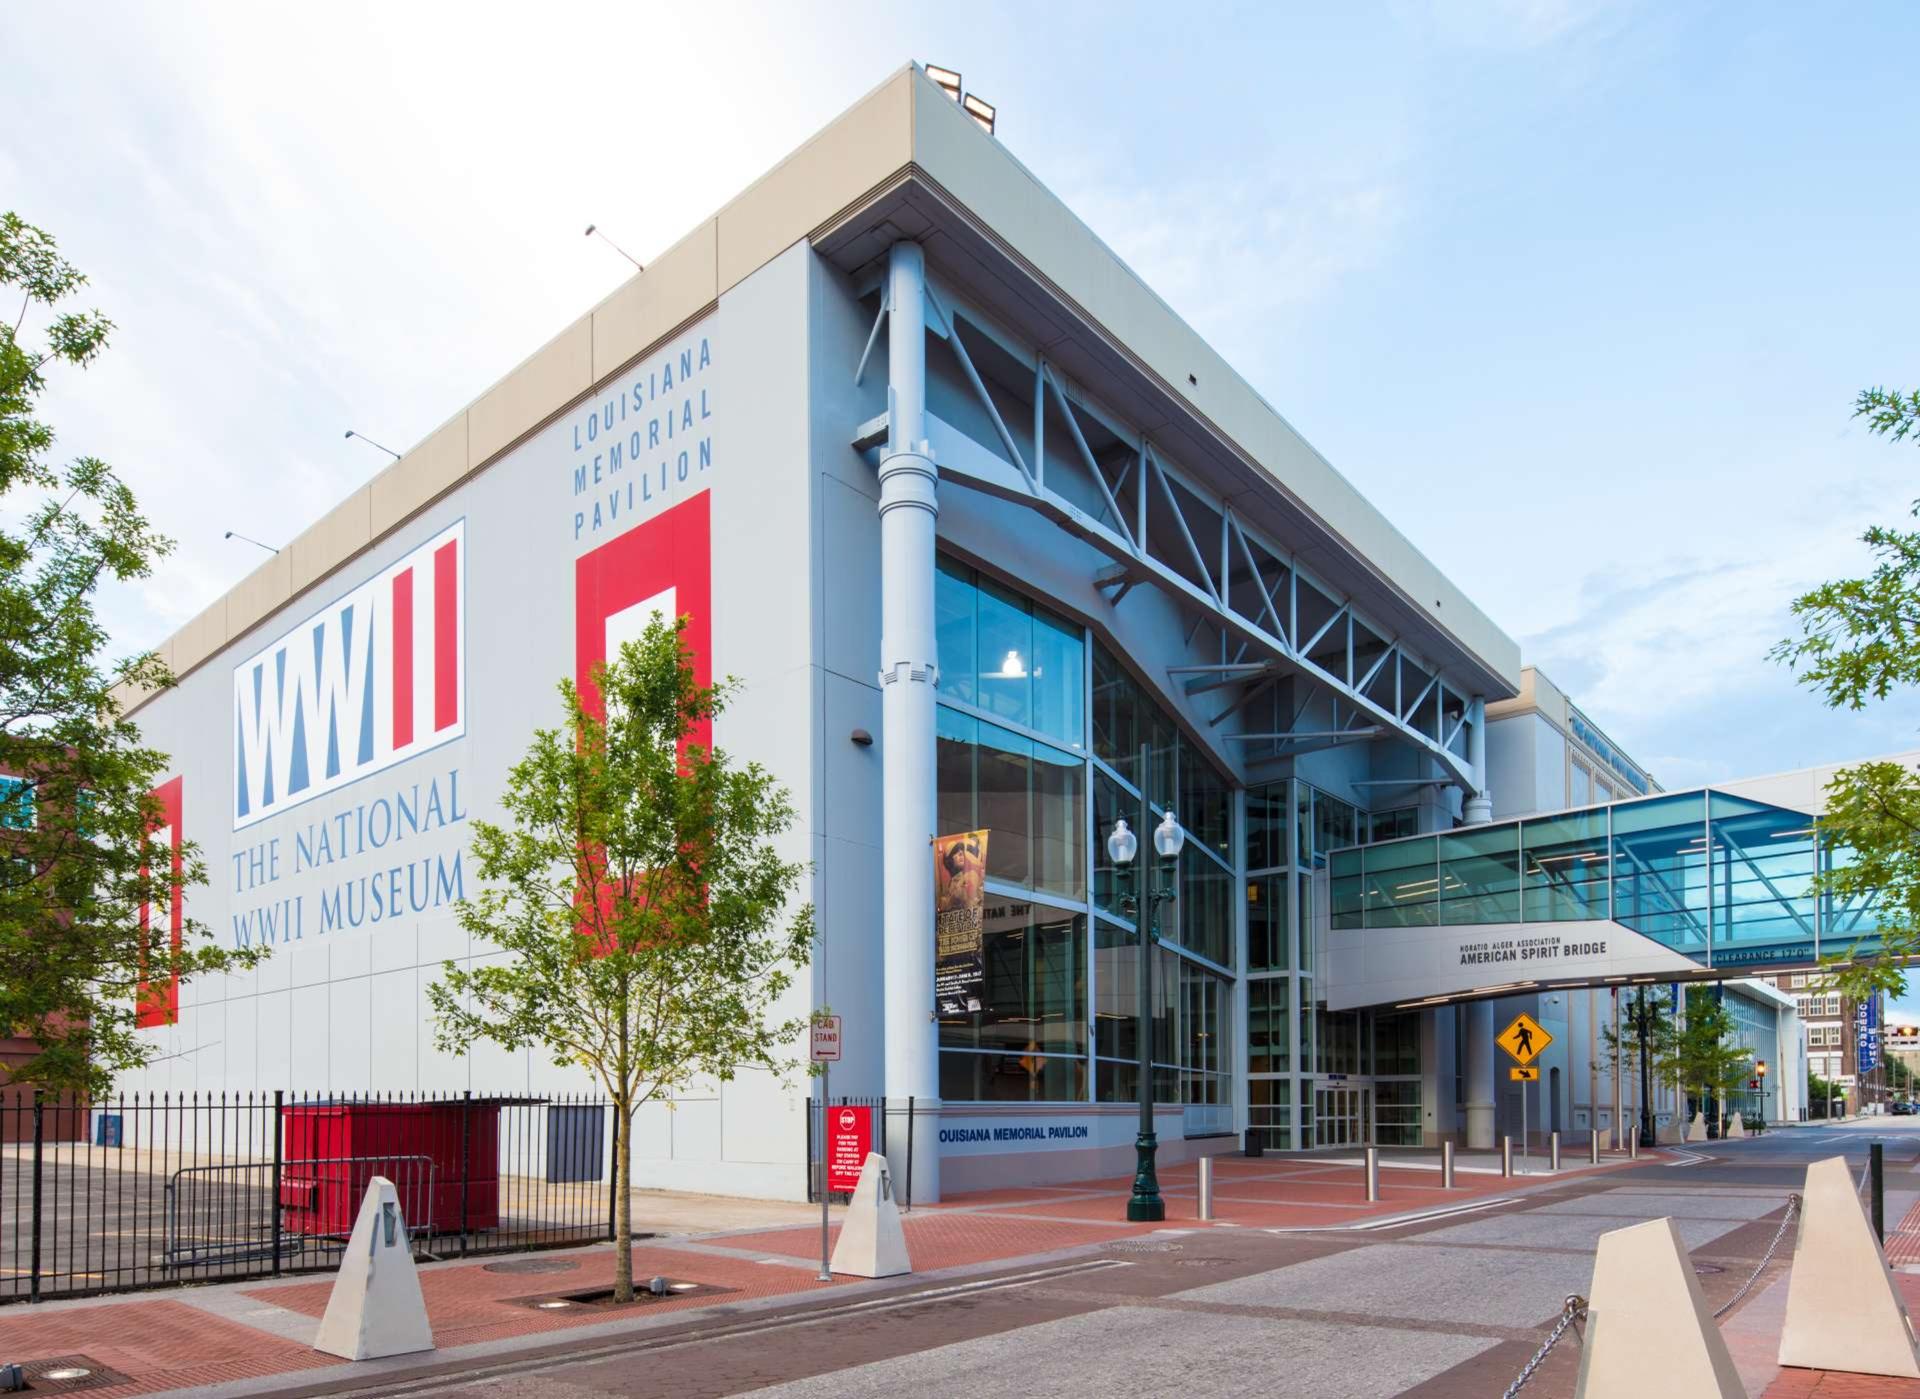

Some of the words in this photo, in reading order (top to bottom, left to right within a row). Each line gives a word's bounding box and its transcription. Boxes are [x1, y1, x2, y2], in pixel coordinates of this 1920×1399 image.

[574, 338, 710, 451] LOUISIANA
[574, 389, 711, 496] MEMORIAL
[575, 437, 710, 540] PAVILION
[236, 538, 458, 818] WWII
[232, 838, 280, 893] THE
[295, 768, 467, 874] NATIONAL
[233, 895, 303, 950] WWII
[319, 848, 467, 935] MUSEUM
[1460, 943, 1488, 953] HORATIO
[1492, 941, 1513, 950] ALGER
[1517, 937, 1561, 948] ASSOCIATION
[1460, 950, 1517, 965] AMERICAN
[1521, 946, 1559, 960] SPIRIT
[1564, 942, 1606, 956] BRIDGE
[1716, 951, 1776, 964] CLEARANCE
[818, 1019, 834, 1029] CAB
[815, 1032, 837, 1042] STAND
[840, 1116, 855, 1124] STOP
[939, 1128, 990, 1143] OUISIANA
[993, 1127, 1046, 1141] MEMORIAL
[1049, 1126, 1088, 1139] PAVILION
